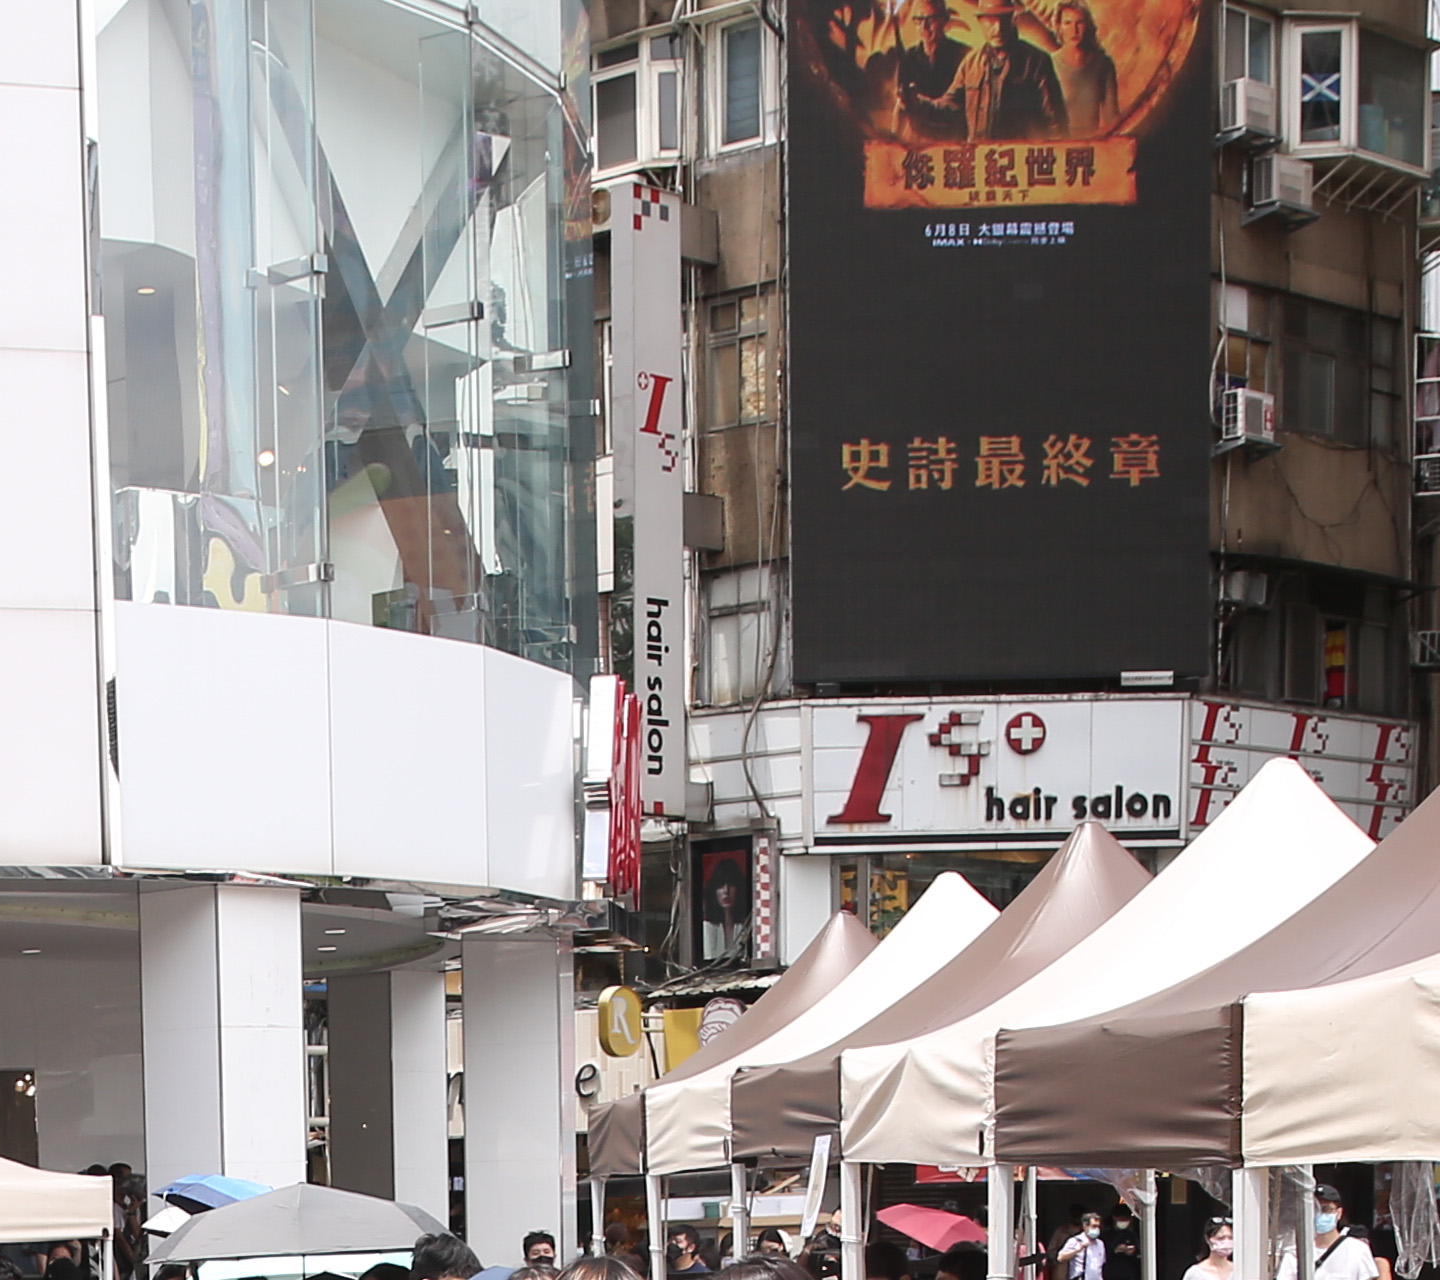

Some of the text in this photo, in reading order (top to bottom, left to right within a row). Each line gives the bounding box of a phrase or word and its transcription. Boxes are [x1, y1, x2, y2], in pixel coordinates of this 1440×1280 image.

[841, 433, 1161, 491] 史詩最終章
[646, 597, 670, 775] hair salon
[984, 784, 1172, 822] hair salon
